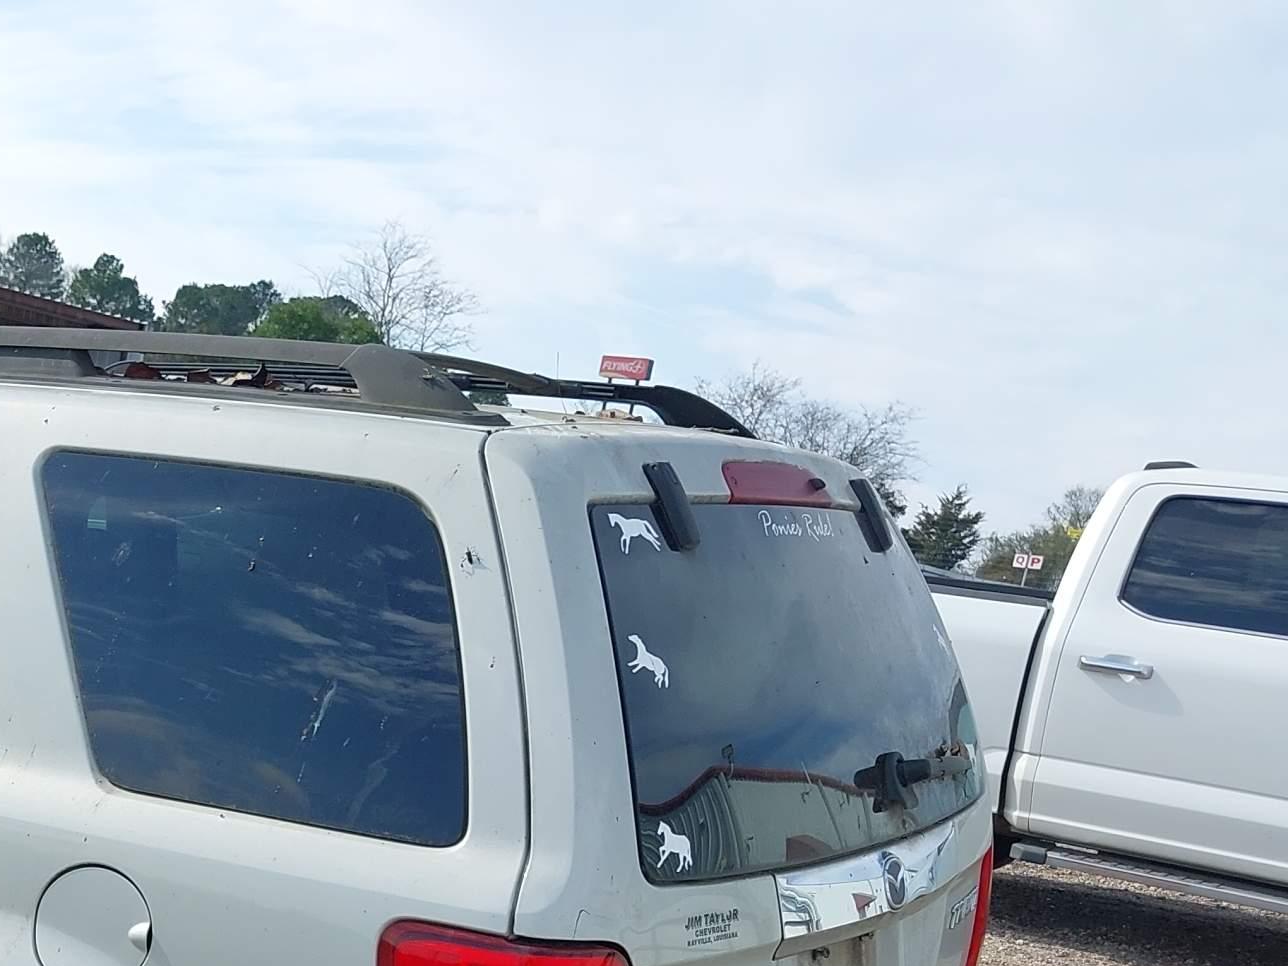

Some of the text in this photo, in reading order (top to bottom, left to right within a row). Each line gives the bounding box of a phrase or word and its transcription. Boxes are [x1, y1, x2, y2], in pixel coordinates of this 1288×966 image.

[602, 360, 633, 372] FLYING
[758, 510, 802, 537] Ponies
[1016, 556, 1025, 566] Q
[1031, 557, 1041, 567] P
[685, 908, 739, 930] JIM TAYLOR
[695, 923, 731, 938] CHEVROLET
